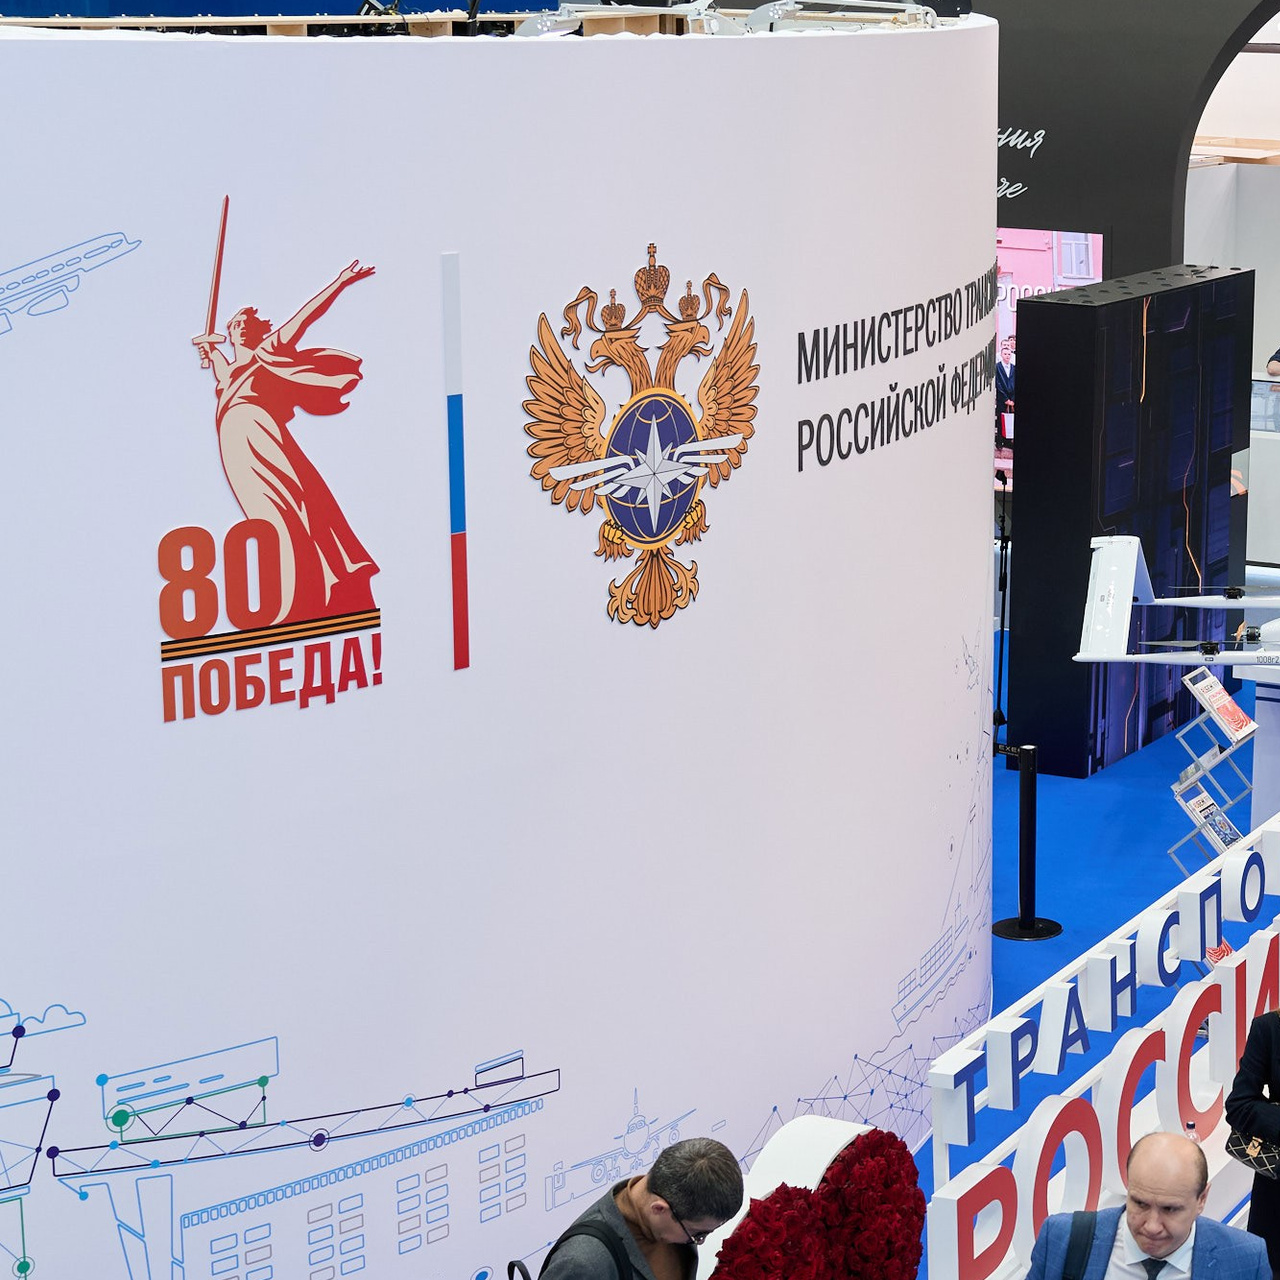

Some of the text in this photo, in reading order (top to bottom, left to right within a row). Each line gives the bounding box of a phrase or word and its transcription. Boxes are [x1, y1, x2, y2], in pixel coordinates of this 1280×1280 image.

[797, 287, 962, 385] МИНИСТЕРСТВО
[797, 364, 947, 472] РОССИЙСКОЙ
[157, 519, 284, 641] 80
[160, 632, 384, 725] ПОБЕДА!
